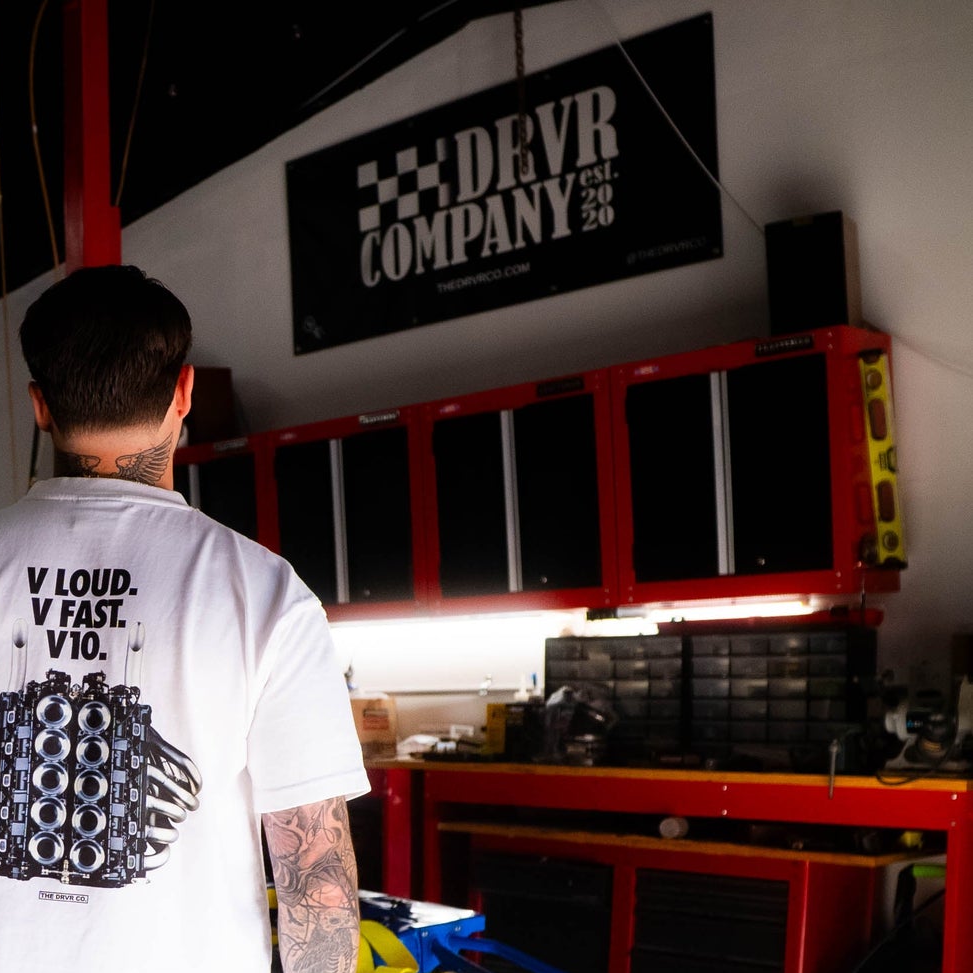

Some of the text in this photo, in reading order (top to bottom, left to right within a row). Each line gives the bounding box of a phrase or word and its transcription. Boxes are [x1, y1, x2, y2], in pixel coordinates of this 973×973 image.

[454, 85, 619, 203] DRVR
[580, 161, 619, 187] est.
[360, 172, 576, 288] COMPANY
[437, 262, 531, 294] THEDRVRCO.COM
[27, 567, 138, 597] V LOUD.
[31, 597, 126, 628] V FAST.
[46, 629, 107, 660] V10.
